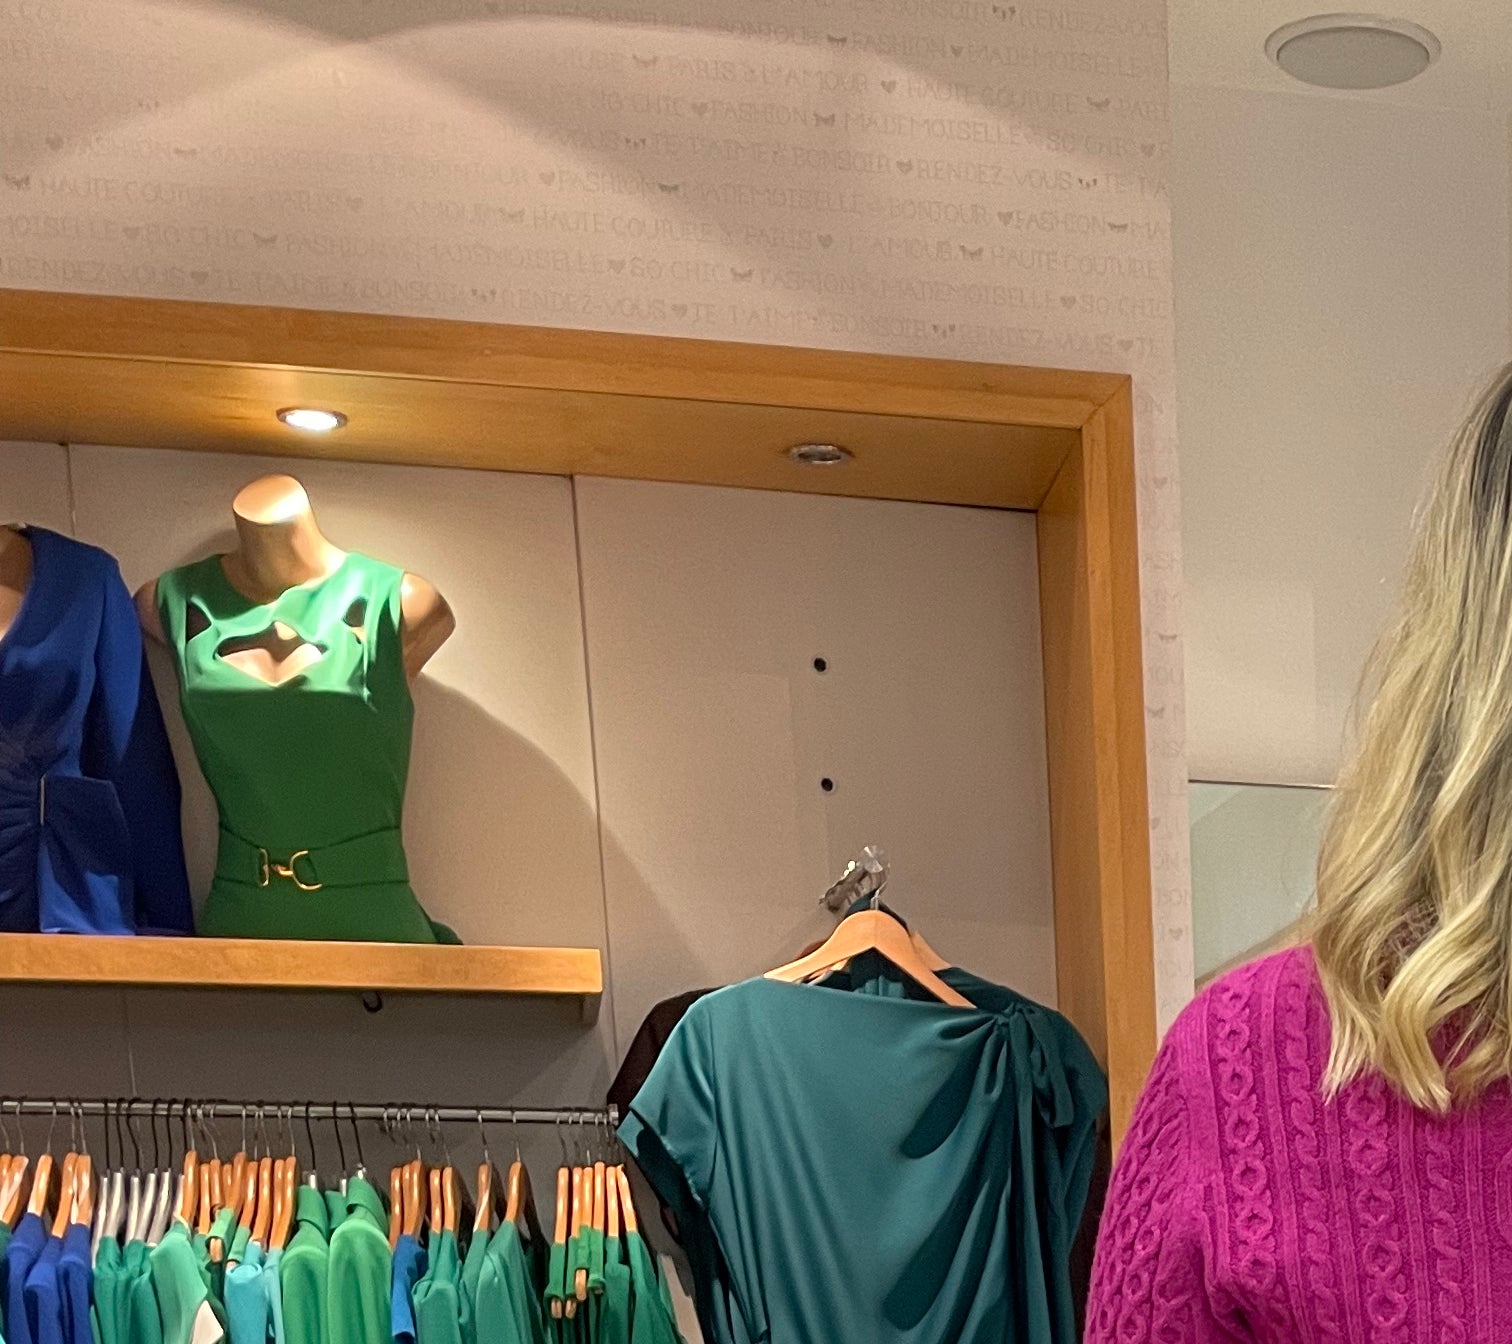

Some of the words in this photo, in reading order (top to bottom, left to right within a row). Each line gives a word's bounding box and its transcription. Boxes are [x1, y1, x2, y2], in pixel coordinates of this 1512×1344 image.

[843, 111, 1022, 146] MADEMOISELLE
[917, 158, 1074, 193] RENDEZ-VOUS
[991, 245, 1060, 272] HAUTE
